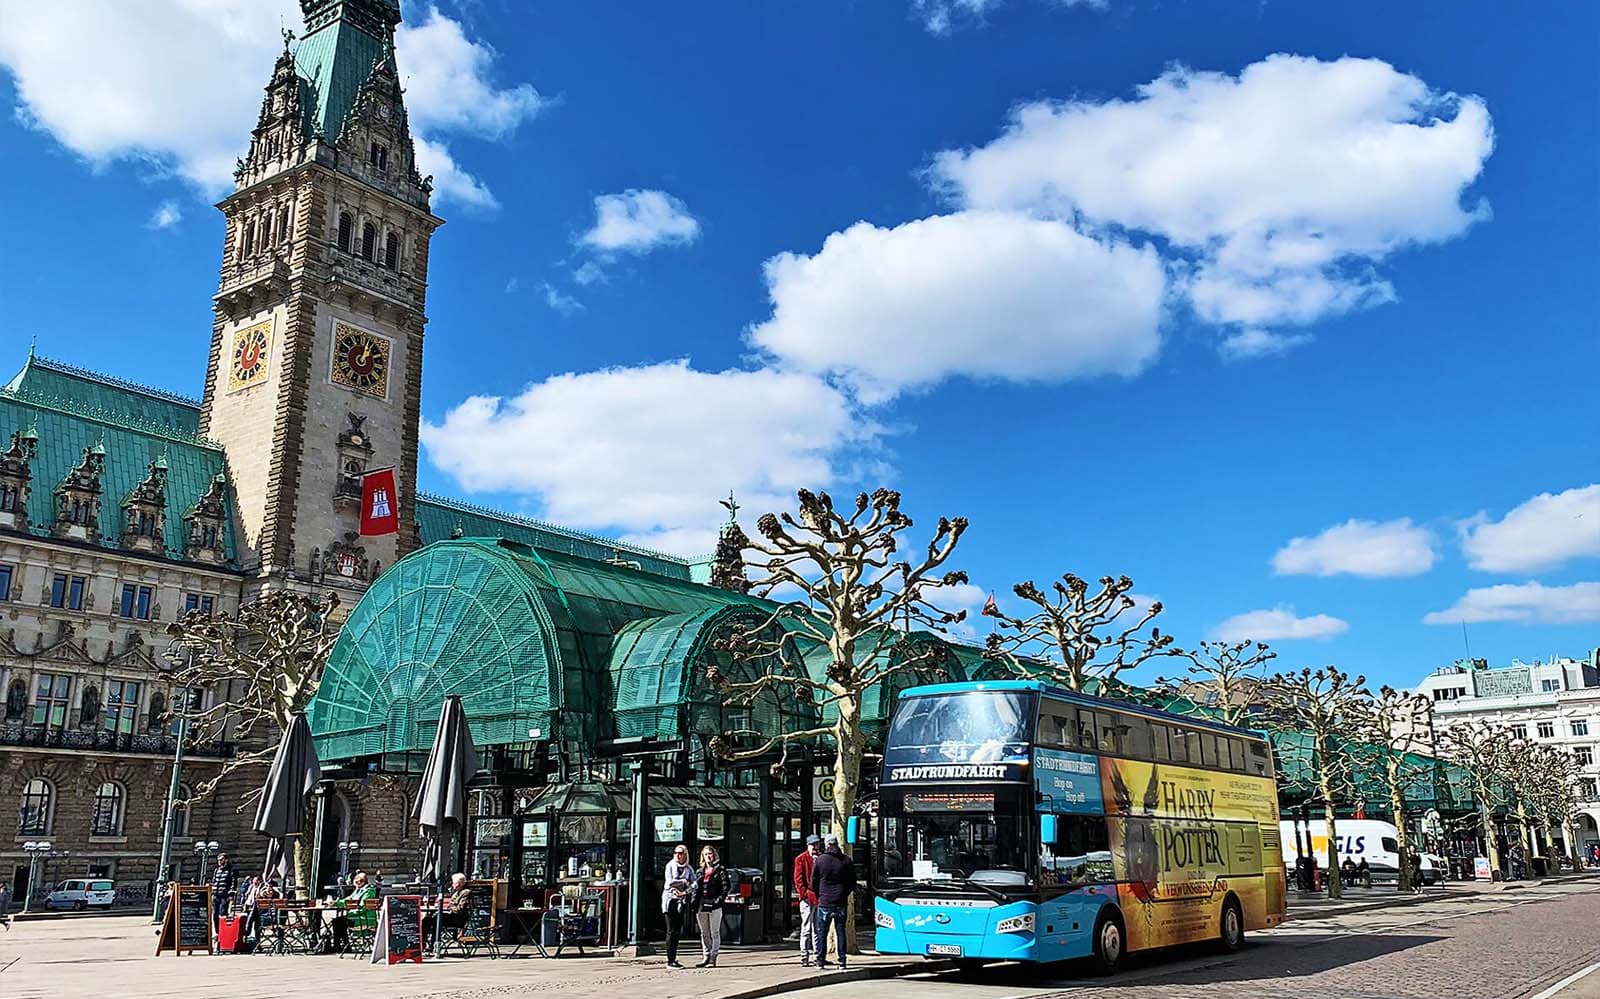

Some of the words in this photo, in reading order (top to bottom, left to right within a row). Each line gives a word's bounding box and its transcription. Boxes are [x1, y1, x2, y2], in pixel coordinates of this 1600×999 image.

[890, 765, 1008, 780] STADTRUNDFAHRT
[1161, 781, 1215, 822] HARRY
[1162, 824, 1225, 872] POTTER
